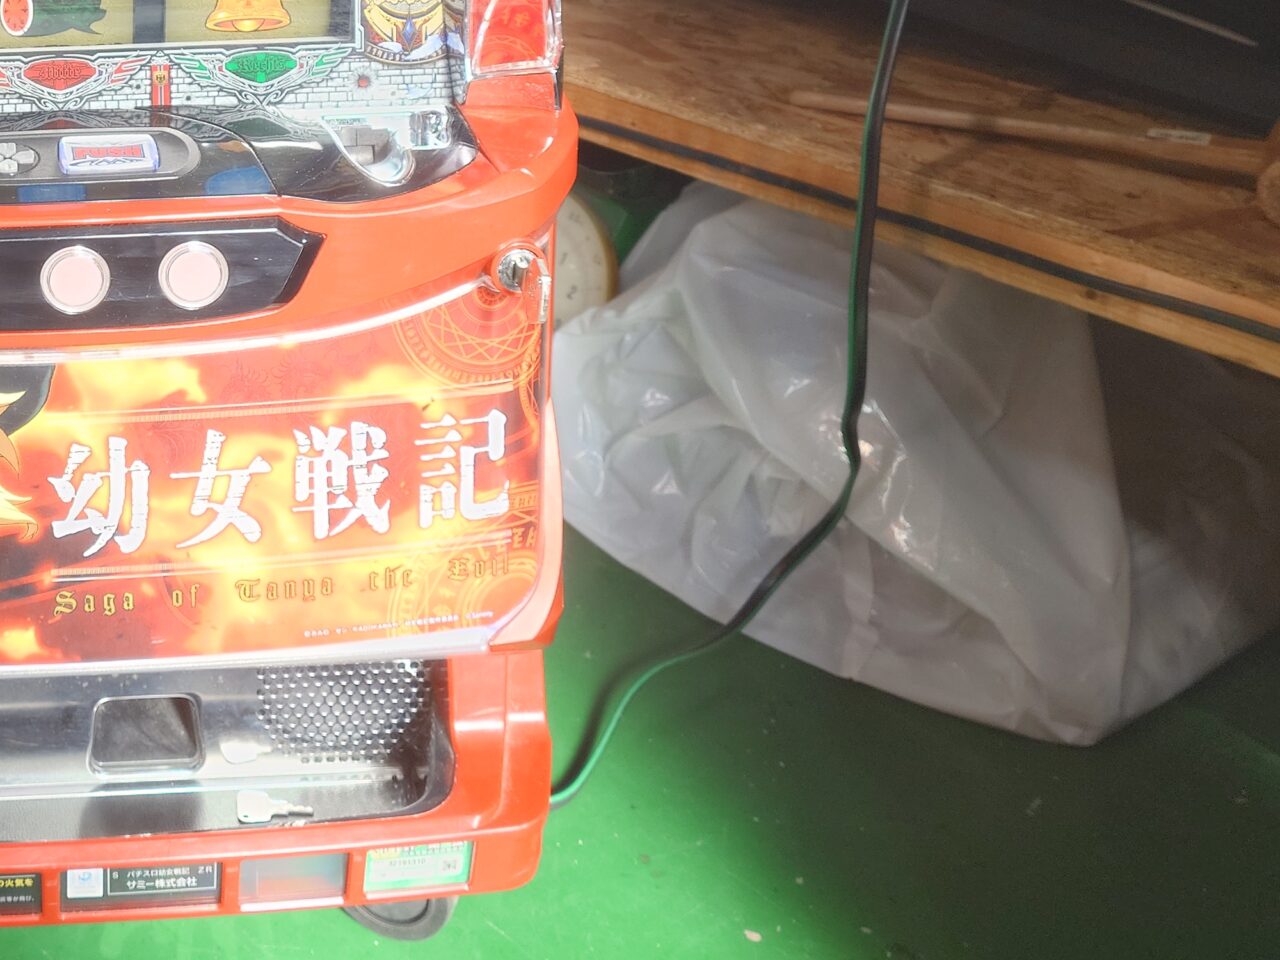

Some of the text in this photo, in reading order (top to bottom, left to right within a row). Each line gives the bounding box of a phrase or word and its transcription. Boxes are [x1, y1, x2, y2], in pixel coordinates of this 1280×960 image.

[72, 144, 145, 160] PUSH
[47, 407, 510, 557] 幼女戦記
[53, 552, 509, 617] Saga of Tanya the Evil
[126, 877, 198, 890] サミー株式会社
